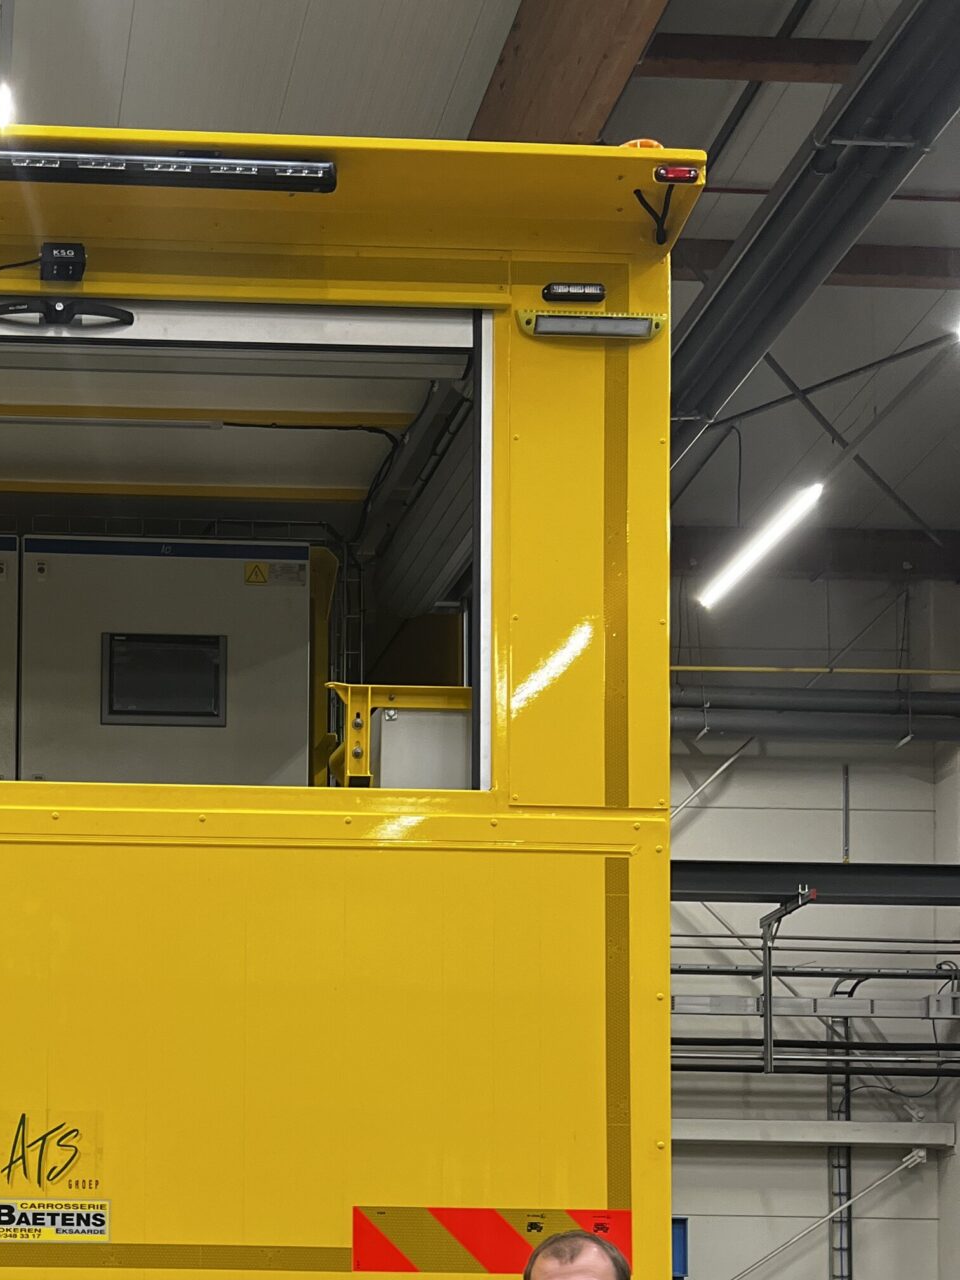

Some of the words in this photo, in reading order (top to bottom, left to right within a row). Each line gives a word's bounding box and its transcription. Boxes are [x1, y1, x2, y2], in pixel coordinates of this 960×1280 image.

[0, 1112, 80, 1188] ATS
[68, 1179, 100, 1190] GROEP
[20, 1202, 108, 1210] CARROSSERIE
